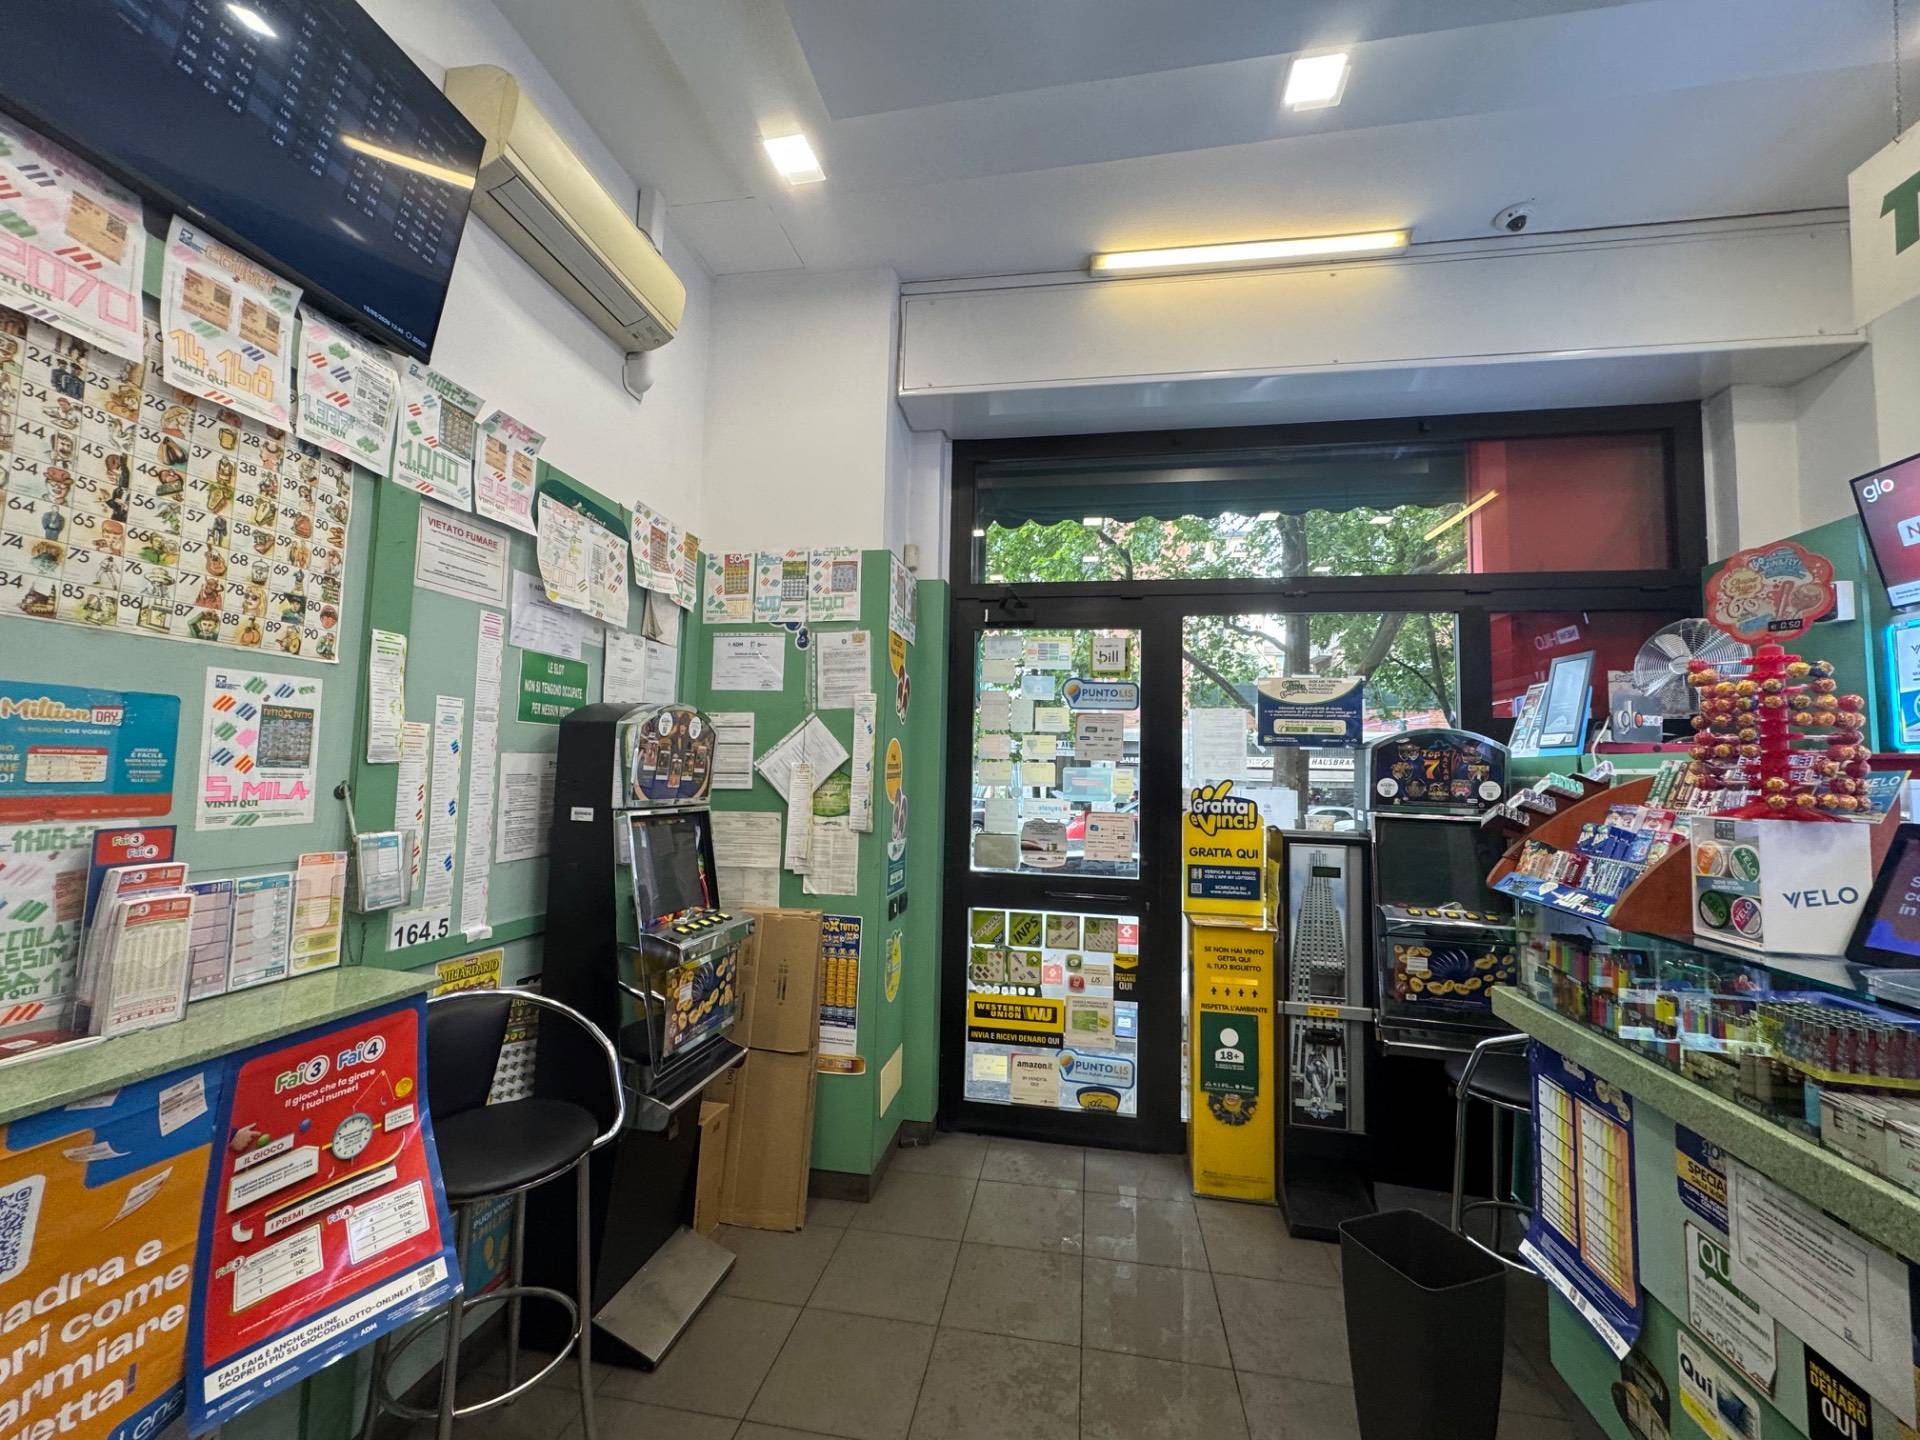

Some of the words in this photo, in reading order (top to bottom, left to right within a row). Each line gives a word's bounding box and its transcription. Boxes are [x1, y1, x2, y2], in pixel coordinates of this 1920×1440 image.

[22, 281, 53, 302] QUI
[27, 346, 52, 367] 24
[171, 354, 206, 378] VINTI
[87, 371, 110, 391] 25
[22, 382, 48, 403] 34
[144, 393, 167, 412] 26
[83, 405, 106, 424] 35
[197, 414, 217, 430] 27
[17, 422, 46, 439] 44
[138, 426, 162, 444] 36
[242, 432, 260, 448] 28
[81, 443, 104, 459] 45
[191, 445, 212, 460] 37
[11, 457, 38, 475] 54
[239, 462, 257, 477] 38
[321, 464, 335, 477] 30
[399, 460, 421, 475] VINTI
[421, 470, 434, 481] QUI
[75, 476, 98, 493] 55
[1862, 477, 1895, 503] glo
[8, 496, 35, 514] 64
[132, 493, 156, 510] 56
[318, 493, 333, 505] 40
[72, 512, 96, 529] 65
[315, 518, 328, 531] 50
[2, 532, 24, 550] 74
[127, 527, 150, 543] 66
[427, 516, 465, 538] VIETATO
[466, 531, 499, 549] FUMARE
[67, 547, 90, 563] 75
[312, 546, 326, 558] 60
[124, 560, 143, 575] 76
[309, 573, 323, 585] 70
[62, 583, 86, 600] 85
[120, 594, 142, 609] 86
[307, 600, 321, 612] 80
[174, 604, 194, 617] 87
[222, 612, 240, 626] 88
[1780, 620, 1801, 629] 0.50
[304, 628, 318, 640] 90
[1099, 650, 1119, 664] bill
[524, 679, 536, 693] NON
[1, 697, 90, 722] Million
[95, 711, 119, 723] DAY
[263, 707, 282, 717] TUTTO
[294, 710, 313, 719] TUTTO
[531, 702, 541, 715] PER
[1423, 759, 1441, 779] 7
[239, 800, 259, 809] QUI
[1192, 798, 1248, 815] Gratta
[1189, 847, 1233, 858] GRATTA
[1236, 848, 1259, 859] QUI
[1783, 886, 1859, 909] VELO
[1734, 900, 1753, 922] VELO
[1899, 903, 1917, 916] in
[394, 917, 449, 948] 164.5
[1013, 916, 1039, 944] INPS
[1213, 946, 1229, 954] NON
[1217, 954, 1237, 962] GETTA
[1229, 964, 1262, 972] BIGLIETTO
[1118, 982, 1132, 990] QUI
[977, 1003, 1021, 1012] WESTERN
[1026, 1006, 1052, 1021] WU
[990, 1011, 1021, 1019] UNION
[1201, 1003, 1230, 1011] RISPETTA
[1231, 1004, 1269, 1014] L'AMBIENTE
[970, 1031, 990, 1039] INVIA
[996, 1033, 1017, 1041] RICEVI
[1018, 1034, 1046, 1044] DENARO
[1047, 1037, 1060, 1045] QUI
[1220, 1051, 1240, 1061] 18+
[291, 1089, 318, 1107] gioco
[319, 1081, 337, 1094] che
[337, 1077, 347, 1090] fa
[347, 1068, 376, 1085] girare
[306, 1096, 325, 1110] tuoi
[325, 1084, 359, 1103] numeri
[243, 1155, 252, 1165] IL
[253, 1142, 285, 1161] GIOCO
[276, 1209, 304, 1229] PREMI
[0, 1256, 125, 1336] adra
[135, 1239, 163, 1267] e
[61, 1263, 190, 1343] come
[219, 1369, 256, 1391] SCOPRI
[257, 1361, 268, 1372] DI
[269, 1351, 286, 1366] PIÙ
[286, 1343, 299, 1356] SU
[300, 1284, 413, 1350] GIOCODELLOTTO-ONLINE.IT
[218, 1366, 239, 1382] FAI3
[241, 1356, 264, 1373] FAI4
[274, 1333, 305, 1354] ANCHE
[306, 1316, 341, 1339] ONLINE.
[1680, 1353, 1713, 1400] Qui
[1809, 1370, 1868, 1428] DENARO
[1821, 1396, 1858, 1440] QUI
